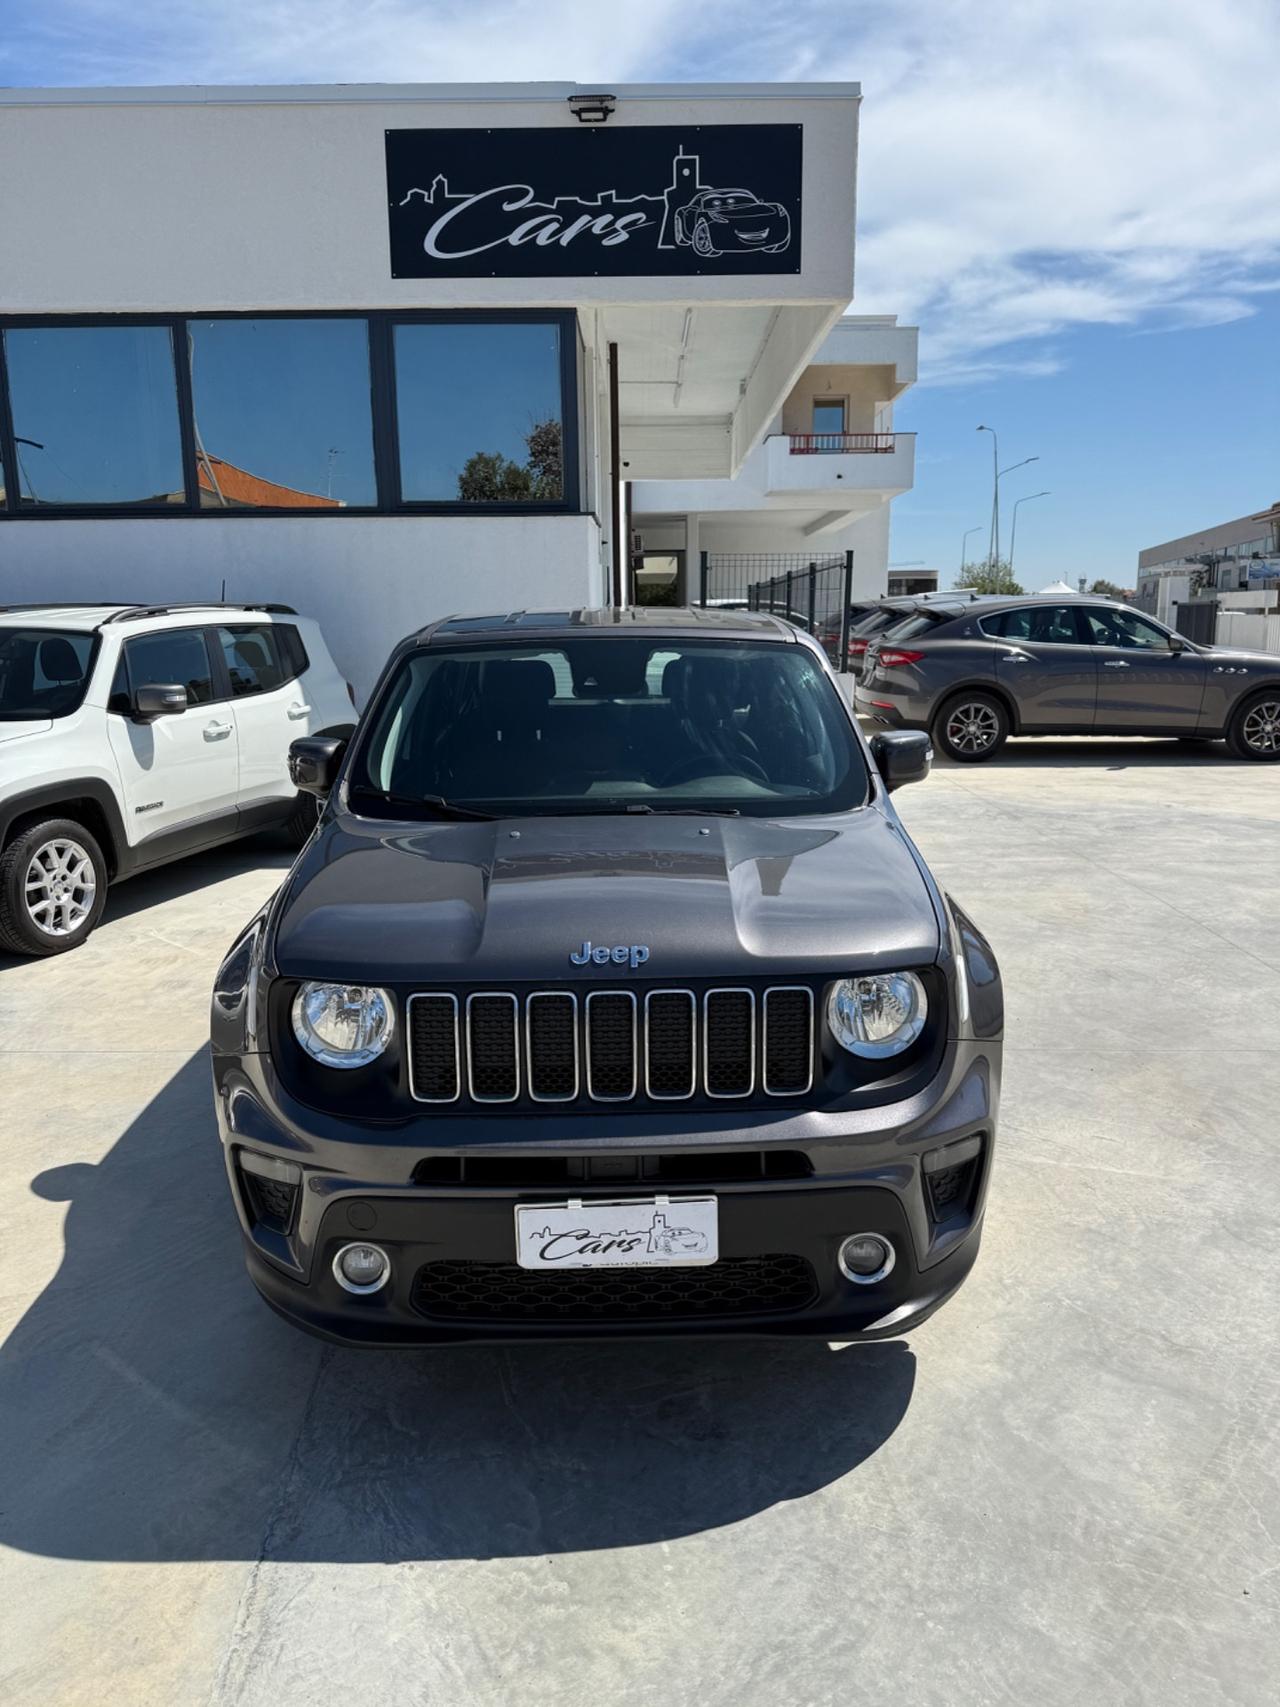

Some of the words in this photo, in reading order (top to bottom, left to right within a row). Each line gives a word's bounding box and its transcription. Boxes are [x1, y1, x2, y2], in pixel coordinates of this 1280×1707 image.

[423, 184, 656, 260] Cars
[570, 941, 650, 968] Jeep
[539, 1229, 643, 1261] Cars
